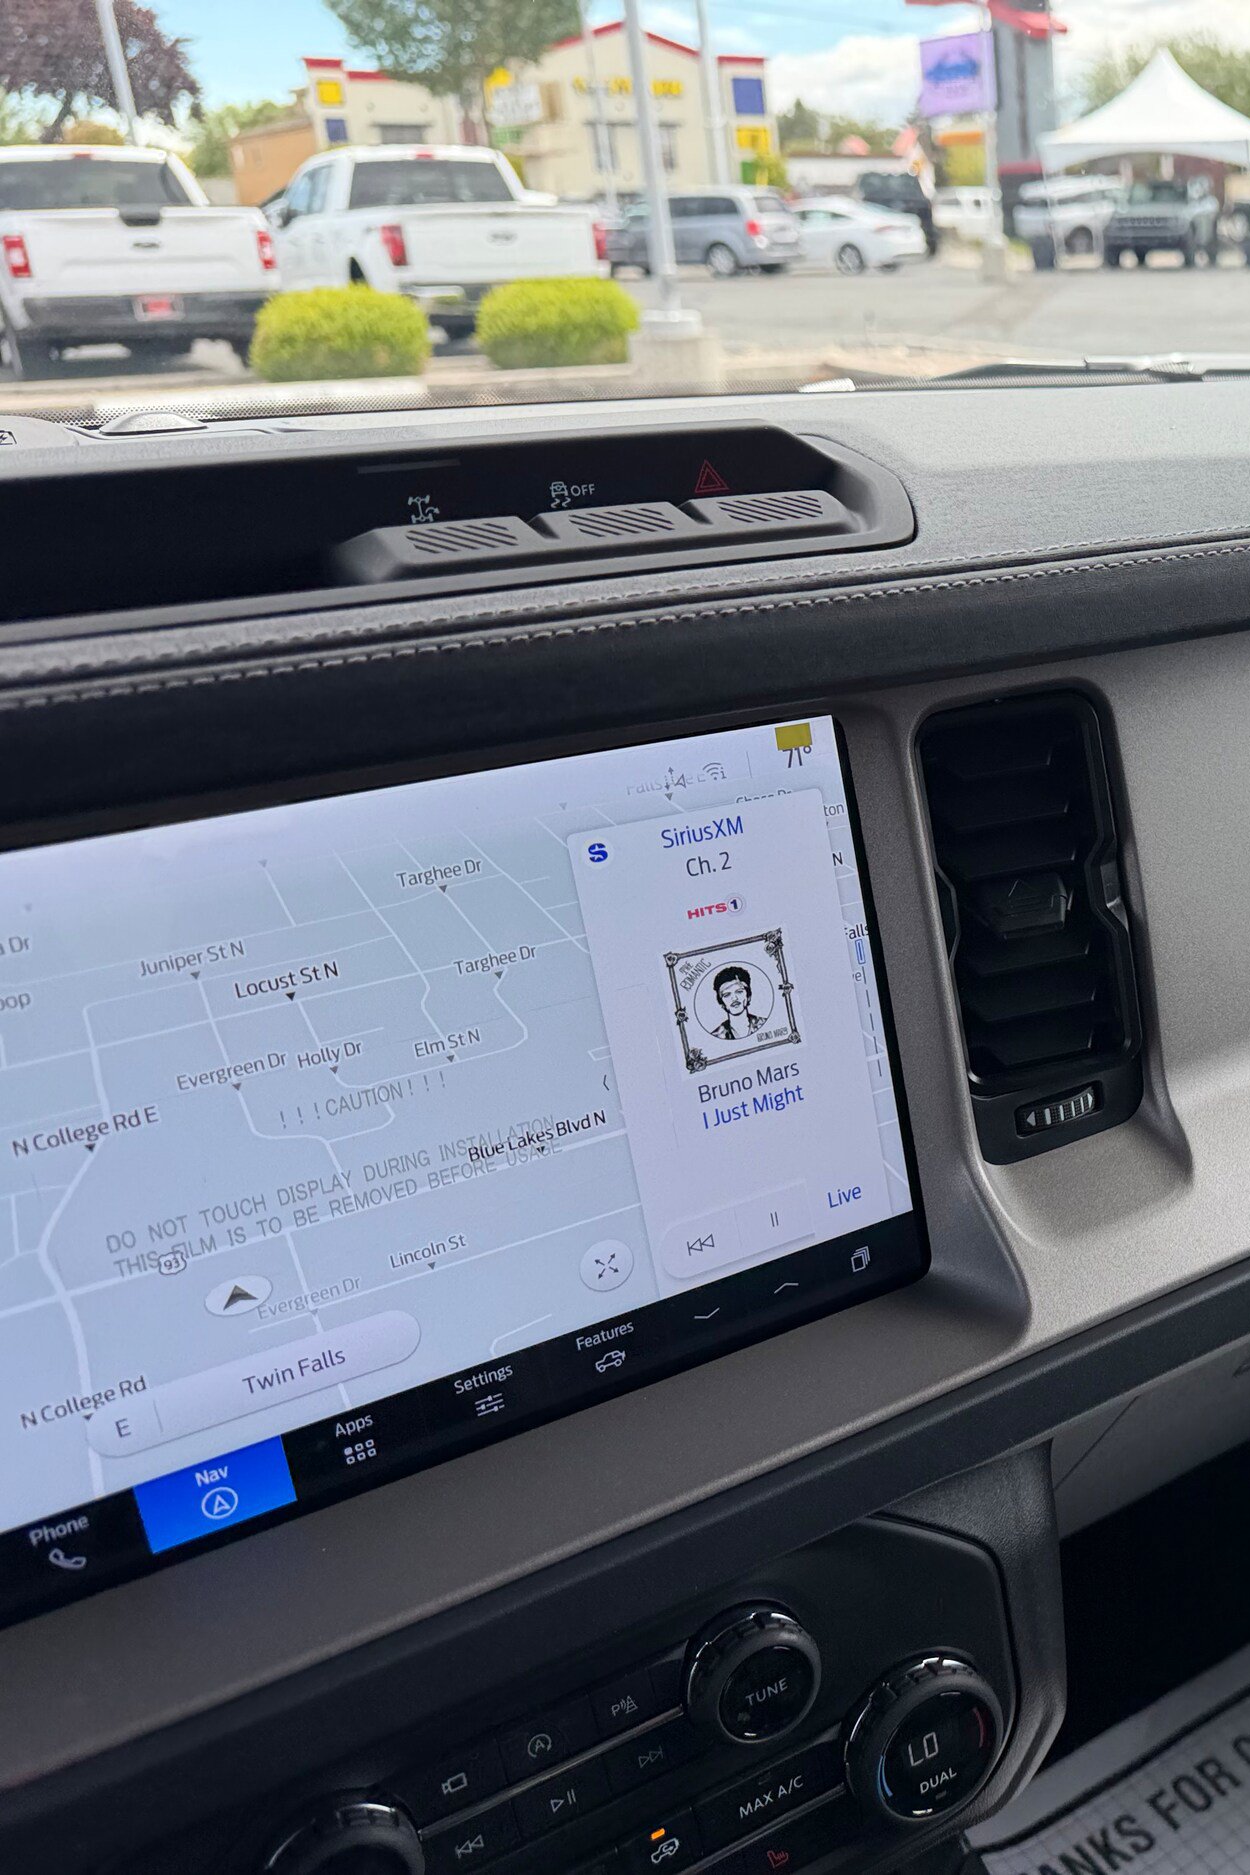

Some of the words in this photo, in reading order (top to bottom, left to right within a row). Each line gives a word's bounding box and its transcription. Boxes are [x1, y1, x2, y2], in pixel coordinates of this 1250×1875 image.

[570, 484, 596, 496] OFF
[661, 816, 744, 848] SiriusXM
[396, 865, 462, 888] Targhee
[464, 859, 482, 877] Dr
[686, 856, 716, 876] Ch.
[719, 851, 732, 870] 2
[9, 936, 30, 953] Dr
[138, 949, 203, 977] Juniper
[207, 944, 226, 962] St
[230, 940, 245, 957] N
[454, 951, 517, 977] Targhee
[519, 945, 537, 961] Dr
[234, 971, 298, 999] Locust
[300, 964, 321, 985] St
[324, 961, 339, 979] N
[297, 1045, 341, 1070] Holly
[342, 1040, 363, 1059] Dr
[414, 1038, 445, 1058] Elm
[448, 1033, 467, 1051] St
[467, 1028, 481, 1044] N
[176, 1058, 266, 1091] Evergreen
[267, 1051, 287, 1069] Dr
[698, 1076, 753, 1103] Bruno
[756, 1062, 800, 1086] Mars
[702, 1112, 708, 1129] I
[713, 1101, 749, 1127] Just
[753, 1085, 804, 1114] Might
[12, 1139, 29, 1158] N
[32, 1117, 109, 1151] College
[112, 1109, 142, 1134] Rd
[145, 1105, 160, 1125] E
[468, 1142, 504, 1162] Blue
[507, 1127, 554, 1151] Lakes
[556, 1115, 591, 1137] Blvd
[593, 1110, 607, 1126] N
[106, 1230, 136, 1253] DO
[148, 1215, 188, 1242] NOT
[199, 1194, 267, 1228] TOUCH
[276, 1169, 352, 1206] DISPLAY
[363, 1150, 431, 1182] DURING
[438, 1115, 557, 1162] INSTALLATION
[827, 1186, 862, 1208] Live
[113, 1251, 160, 1277] THIS
[227, 1226, 247, 1247] IS
[256, 1216, 282, 1237] TO
[293, 1205, 320, 1228] BE
[329, 1178, 418, 1218] REMOVED
[427, 1157, 497, 1189] BEFORE
[505, 1140, 563, 1167] USAGE
[163, 1257, 180, 1271] 93
[389, 1239, 446, 1269] Lincoln
[448, 1234, 466, 1250] St
[257, 1287, 340, 1320] Evergreen
[341, 1277, 361, 1294] Dr
[575, 1321, 635, 1351] Features
[242, 1367, 295, 1394] Twin
[297, 1350, 346, 1377] Falls
[453, 1364, 514, 1394] Settings
[20, 1411, 37, 1429] N
[40, 1389, 116, 1421] College
[120, 1375, 147, 1397] Rd
[116, 1419, 131, 1438] E
[335, 1414, 374, 1439] Apps
[195, 1465, 229, 1488] Nav
[29, 1513, 90, 1547] Phone
[745, 1679, 789, 1706] TUNE
[739, 1793, 775, 1819] MAX
[778, 1775, 805, 1796] A/C
[919, 1768, 957, 1795] DUAL
[1148, 1756, 1242, 1832] FOR
